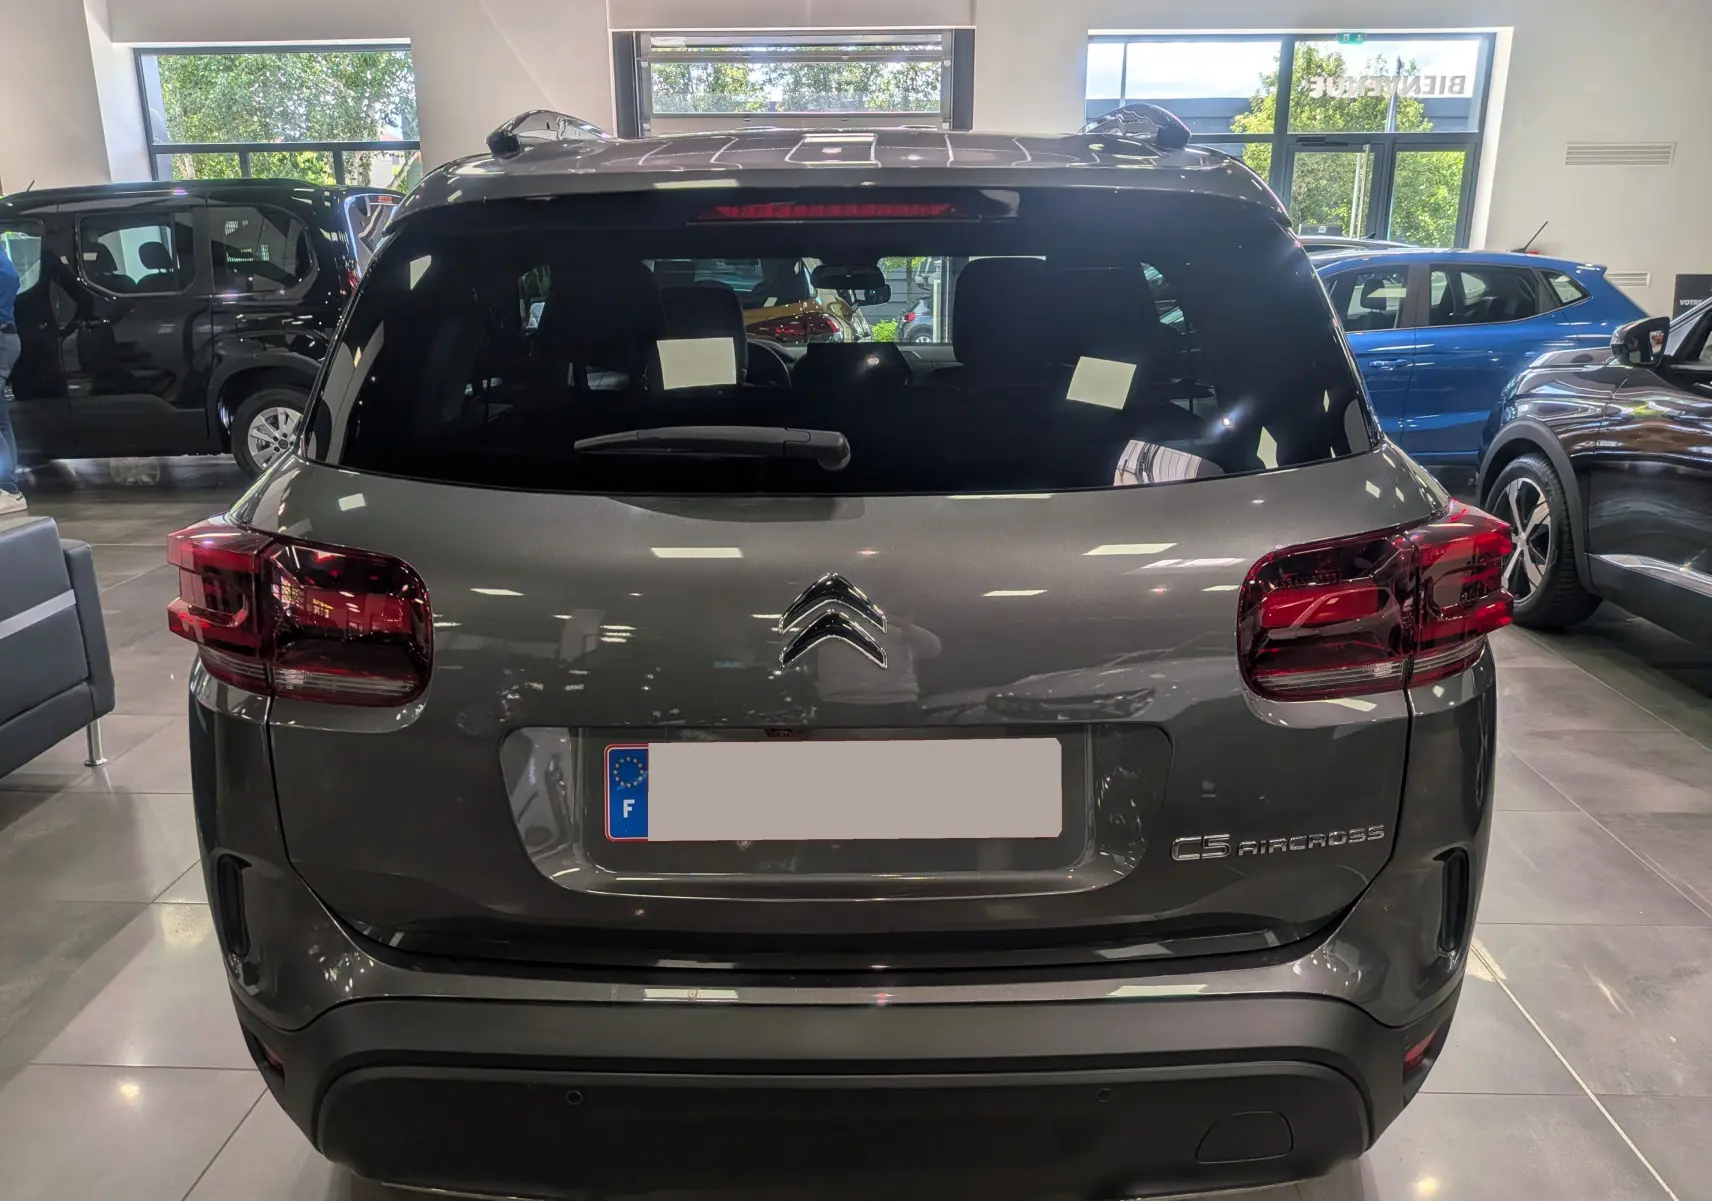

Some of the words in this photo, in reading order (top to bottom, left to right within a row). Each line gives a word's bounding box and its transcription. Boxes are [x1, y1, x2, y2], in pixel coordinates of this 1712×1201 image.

[623, 799, 636, 818] F
[1171, 834, 1231, 861] C5
[1238, 824, 1385, 856] AIRCROSS
